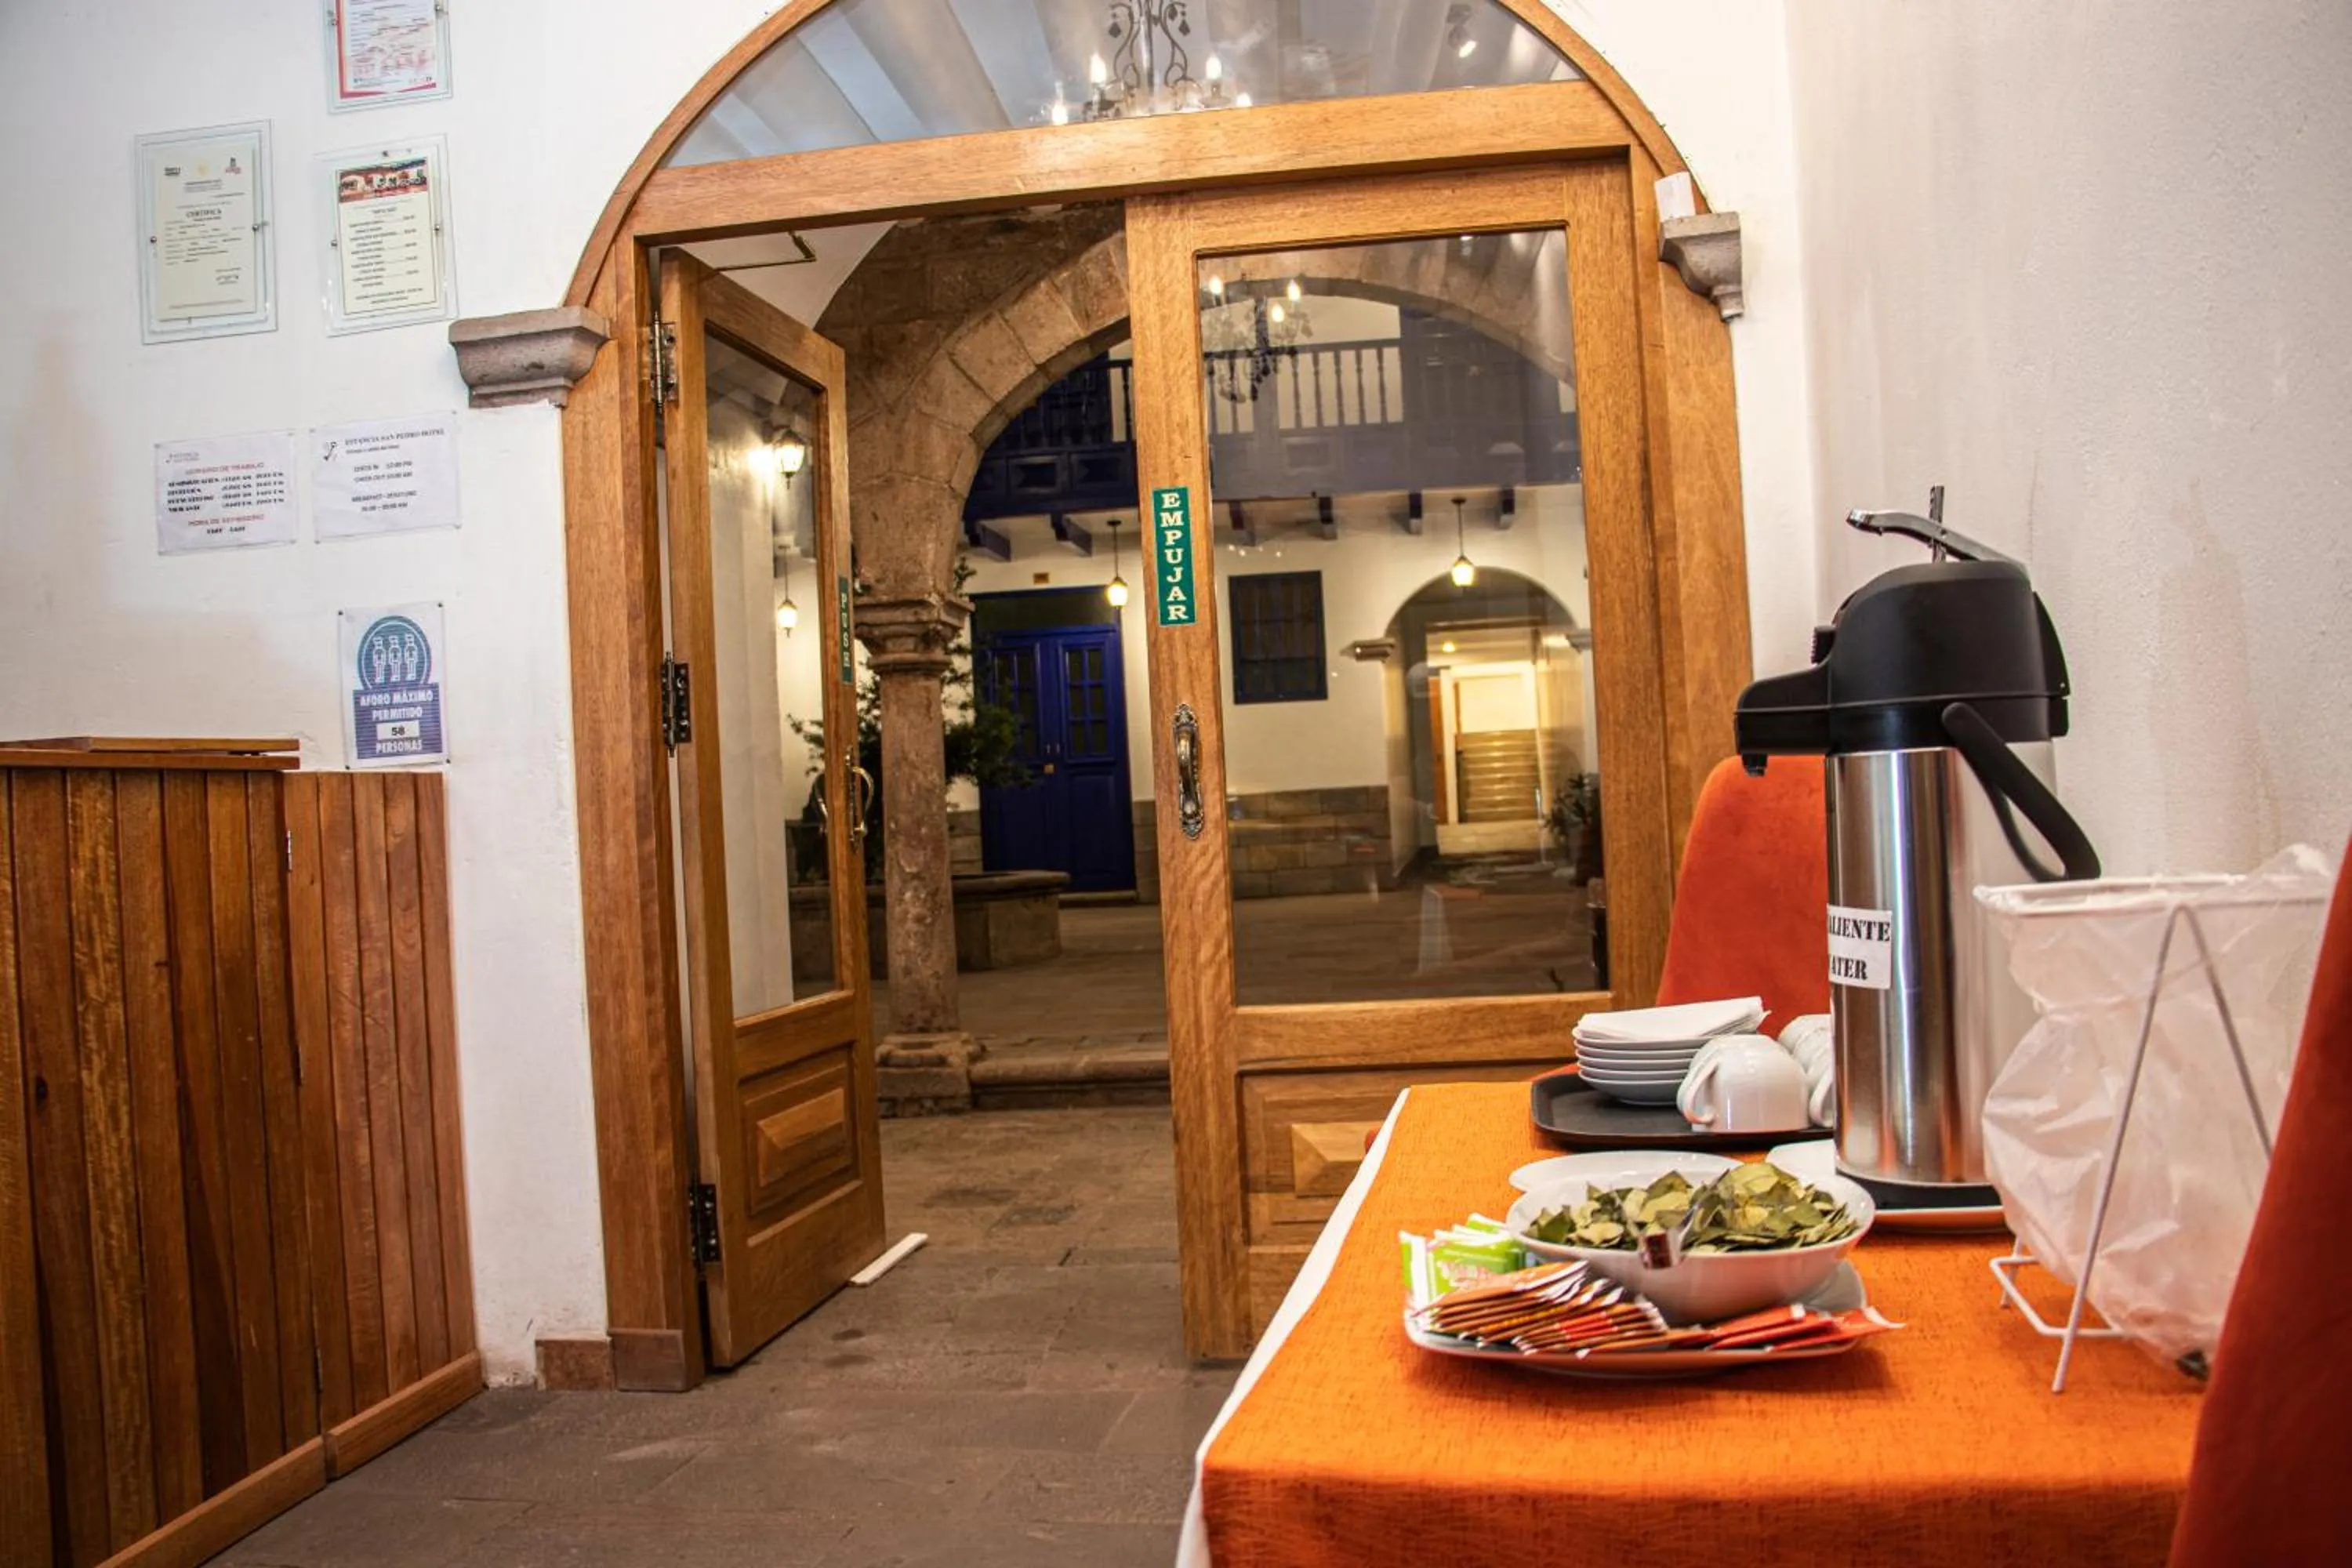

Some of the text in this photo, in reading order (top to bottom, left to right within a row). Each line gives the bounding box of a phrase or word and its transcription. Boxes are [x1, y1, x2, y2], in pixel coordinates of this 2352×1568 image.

[1160, 492, 1189, 620] EMPUJAR
[359, 689, 434, 706] AFORO MÁXIMO
[372, 706, 423, 721] PERMITIDO
[391, 725, 405, 736] 58
[376, 739, 422, 753] PERSONAS
[1828, 953, 1867, 980] ATER
